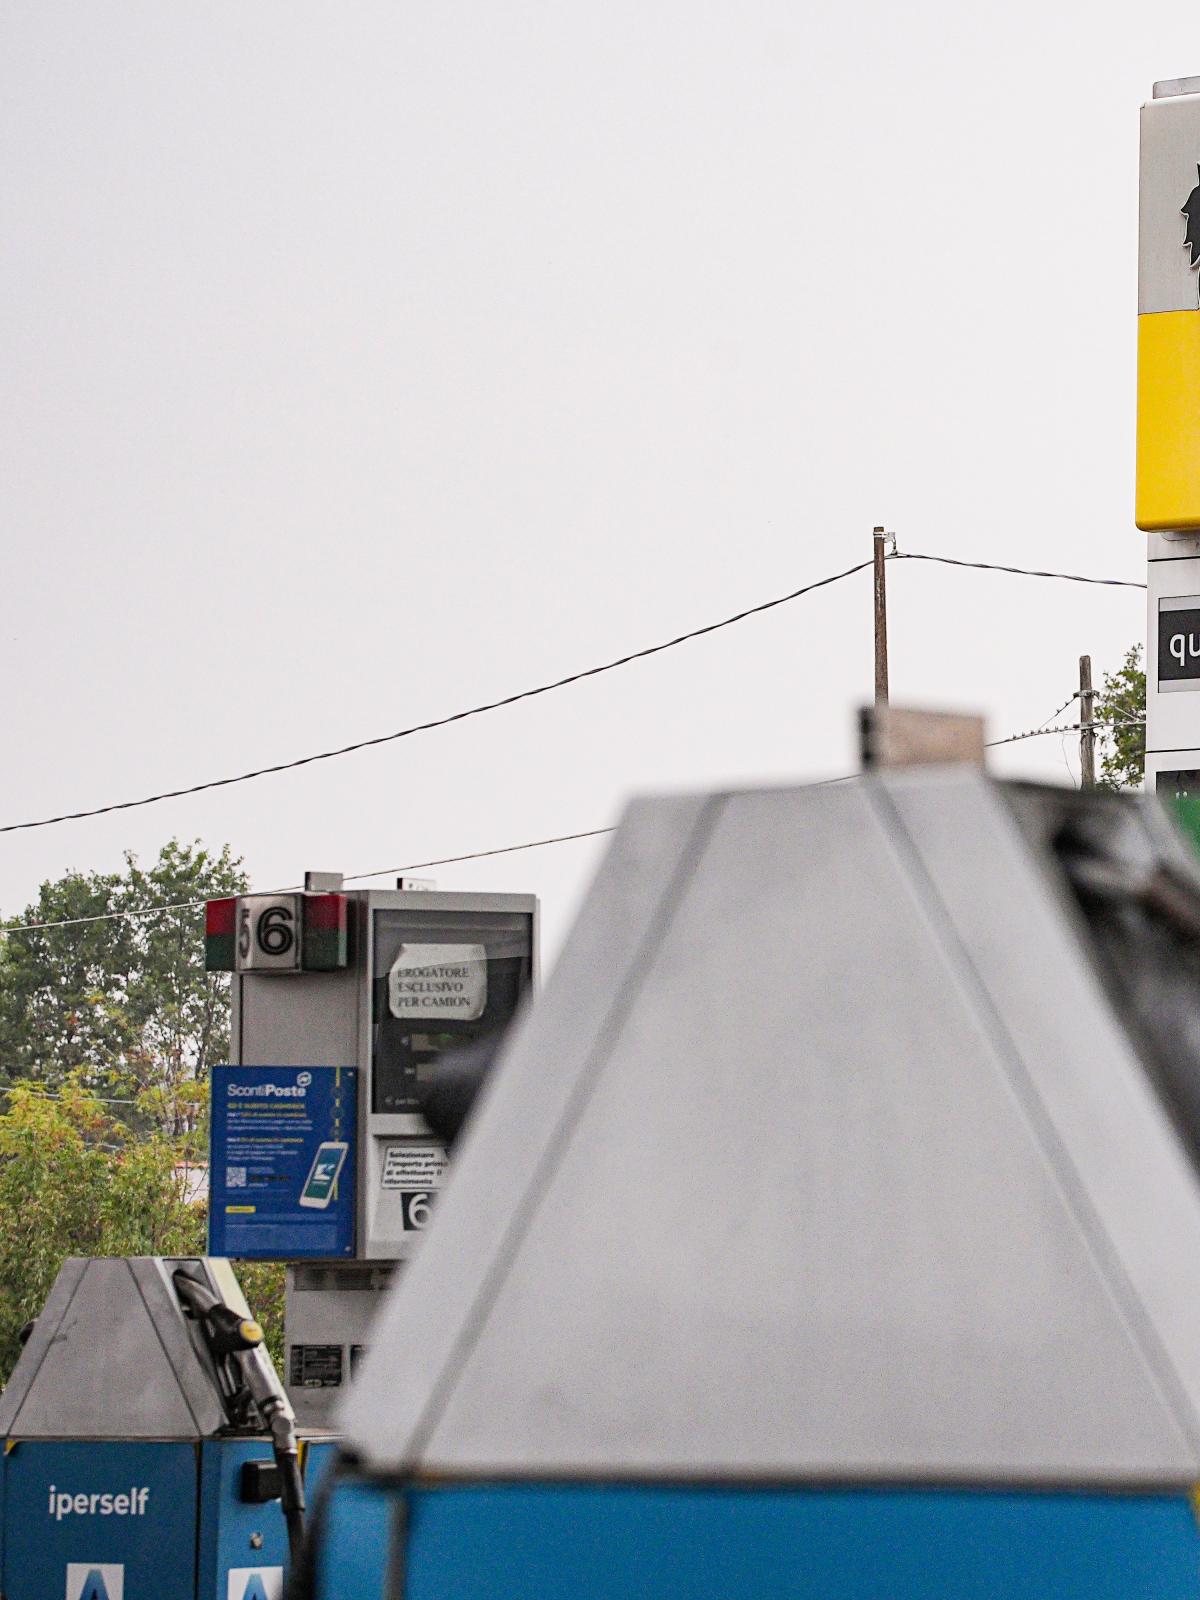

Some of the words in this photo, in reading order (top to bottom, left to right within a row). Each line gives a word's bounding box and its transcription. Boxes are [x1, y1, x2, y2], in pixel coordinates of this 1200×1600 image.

[257, 906, 294, 956] 6
[397, 967, 470, 978] EROGATORE
[397, 982, 465, 993] ESCLUSIVO
[397, 997, 420, 1008] PER
[421, 997, 471, 1008] CAMION
[227, 1083, 307, 1097] ScontiPoste
[408, 1192, 434, 1230] 6
[48, 1485, 149, 1521] iperself
